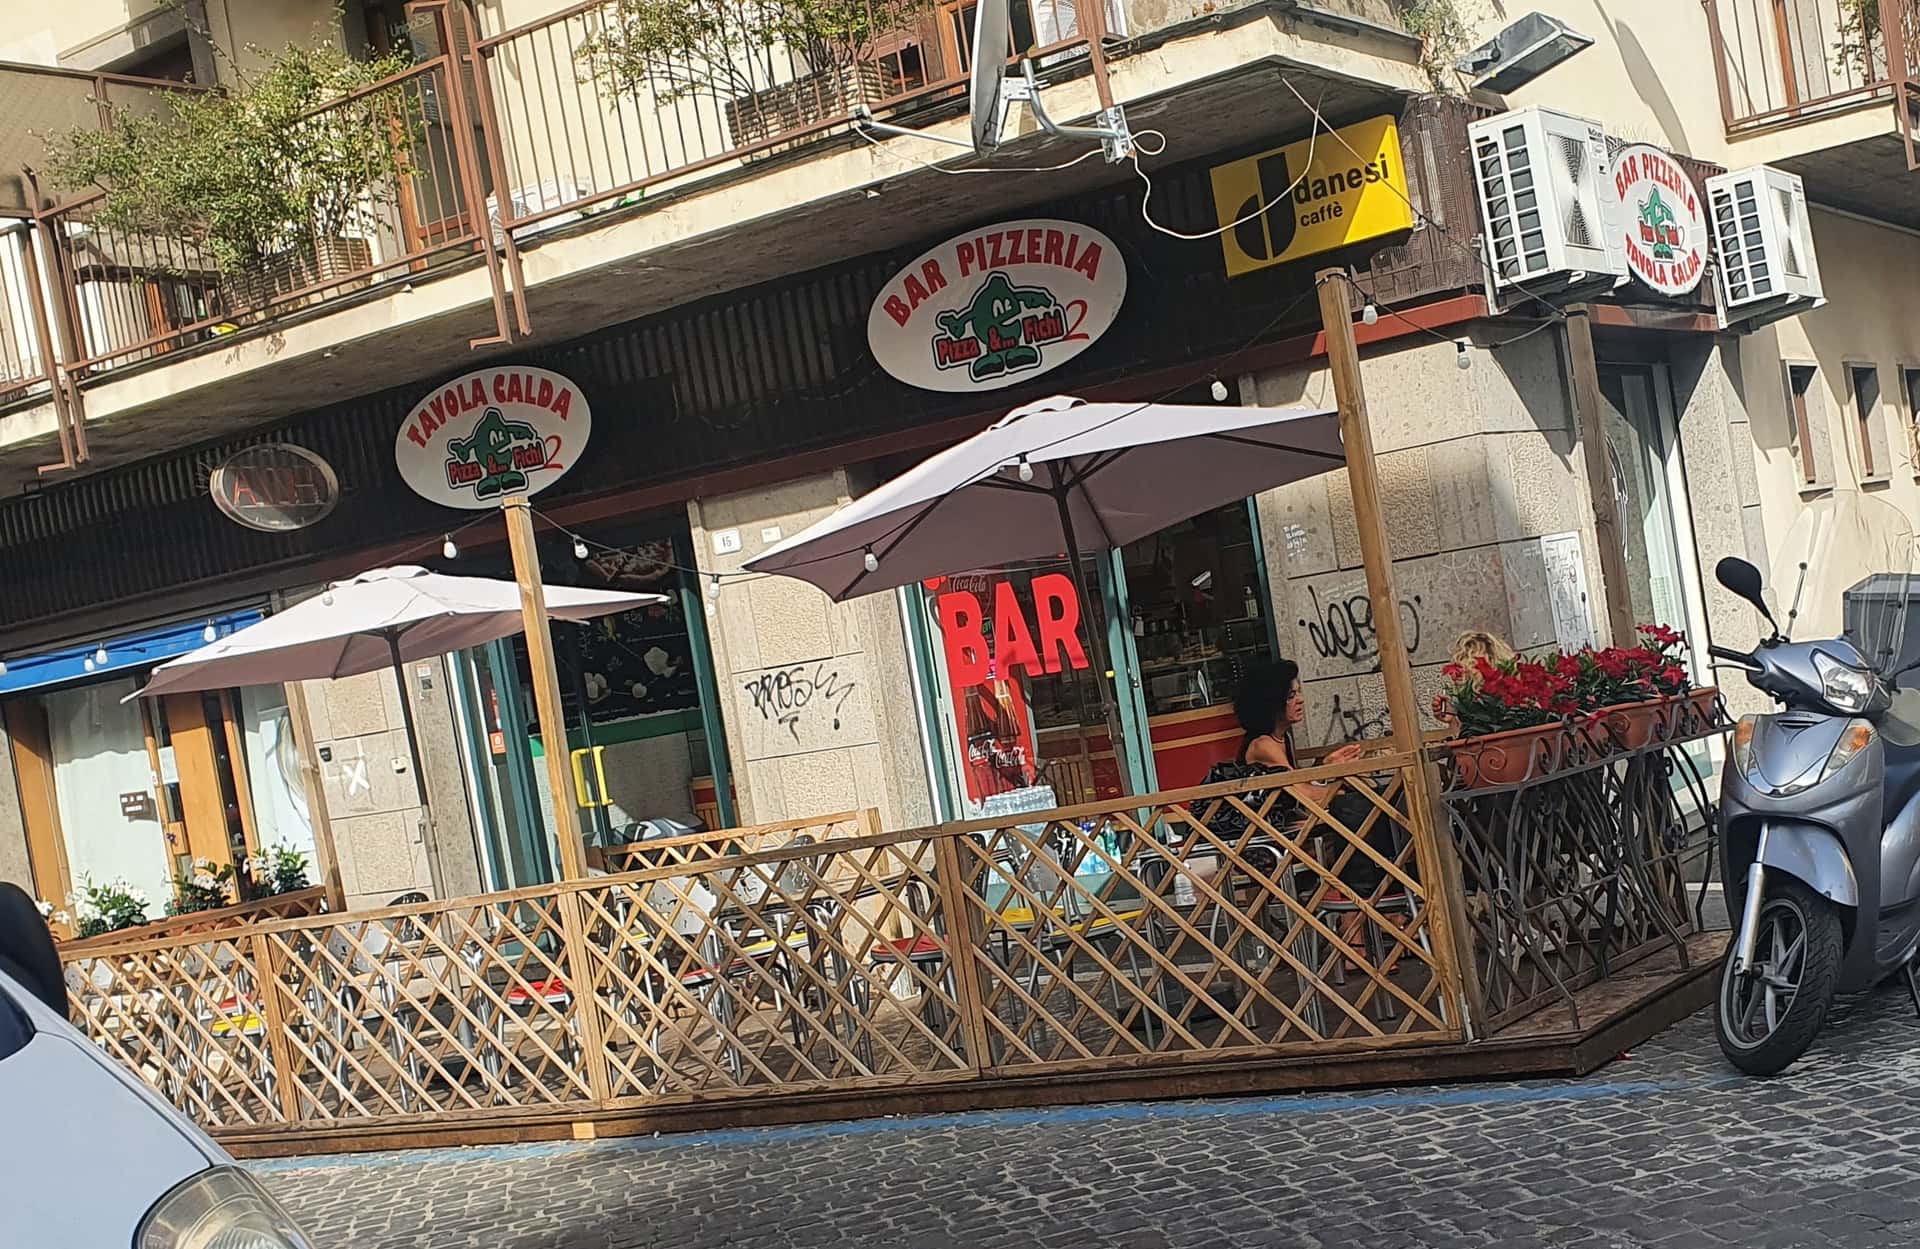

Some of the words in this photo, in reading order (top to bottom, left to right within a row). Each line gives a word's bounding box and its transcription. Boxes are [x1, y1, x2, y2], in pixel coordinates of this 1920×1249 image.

[1294, 153, 1389, 204] danesi
[1615, 155, 1639, 203] BAR
[1641, 153, 1696, 222] PIZZERIA
[1300, 201, 1343, 227] caffè
[883, 258, 948, 328] BAR
[956, 229, 1102, 282] PIZZERIA
[1625, 232, 1668, 287] TAVOLA
[1671, 247, 1701, 287] CALDA
[935, 336, 981, 366] Pizza
[1022, 308, 1064, 344] Fichi
[407, 378, 488, 449] TAVOLA
[493, 373, 572, 421] CALDA
[448, 460, 483, 485] Pizza
[938, 573, 1089, 688] BAR
